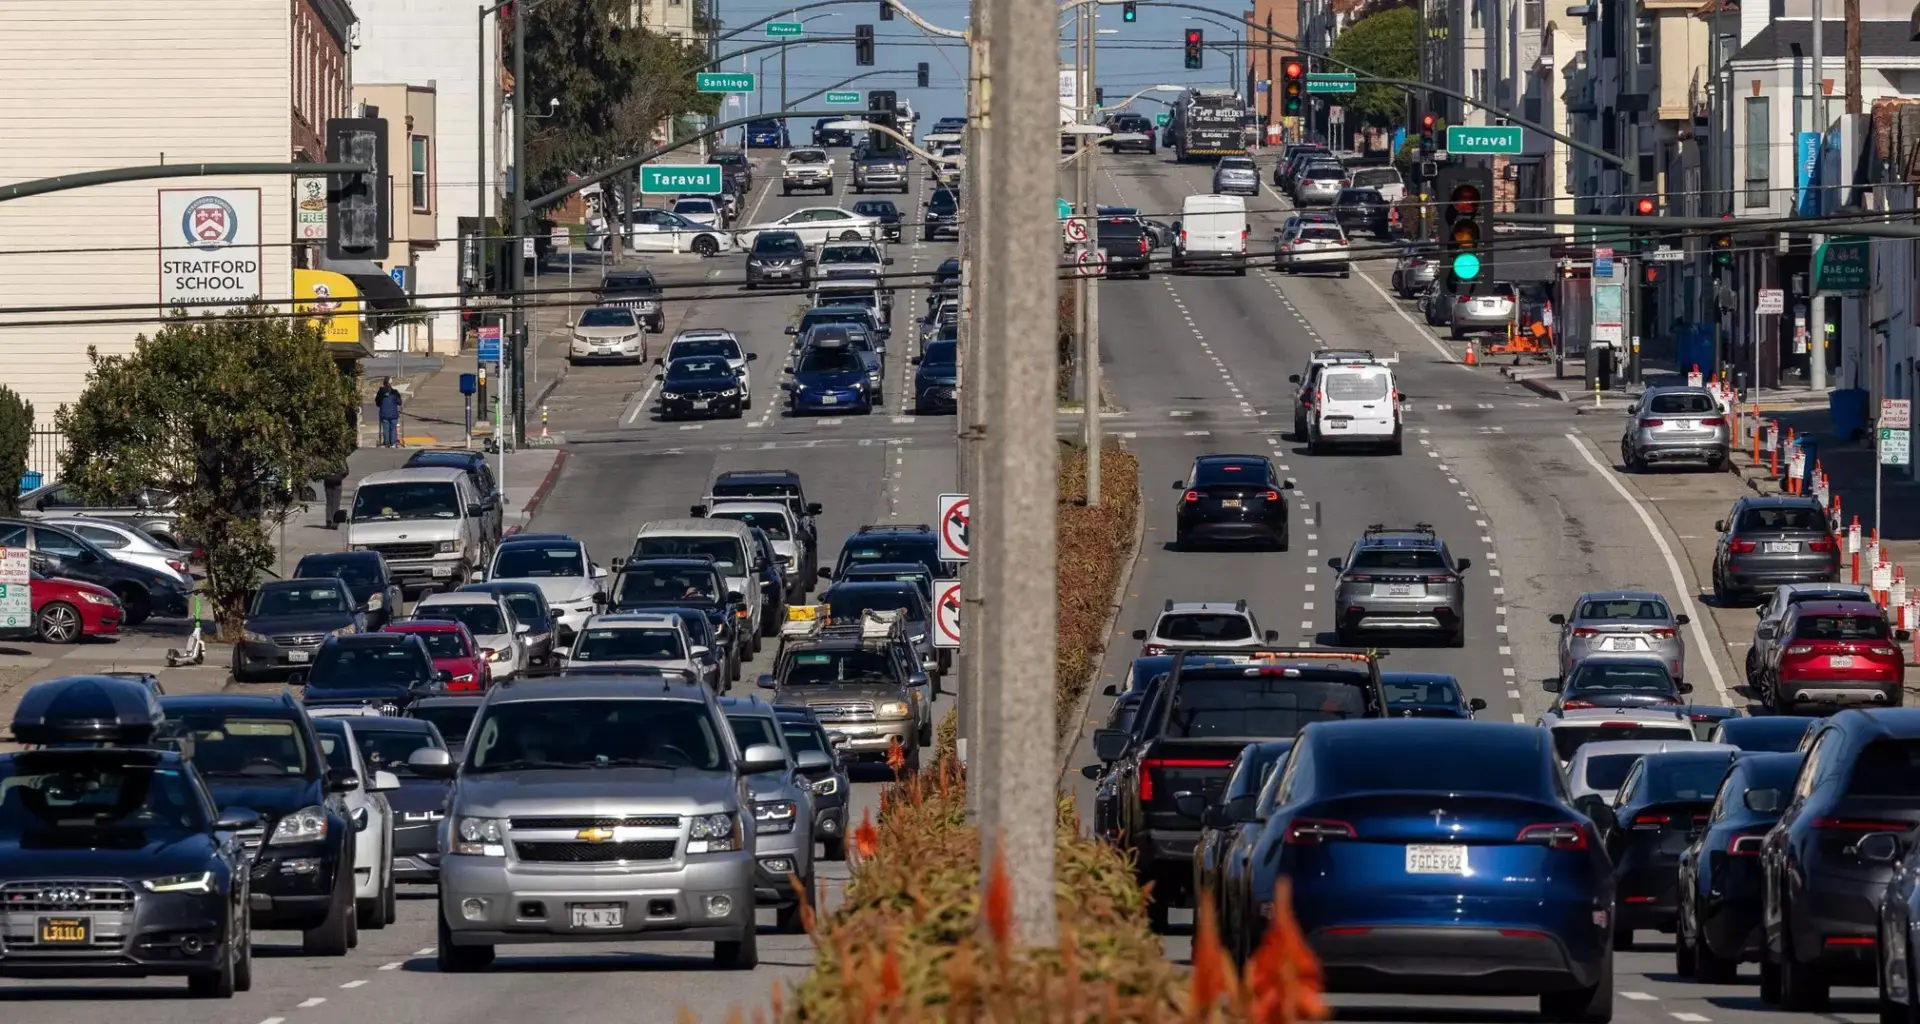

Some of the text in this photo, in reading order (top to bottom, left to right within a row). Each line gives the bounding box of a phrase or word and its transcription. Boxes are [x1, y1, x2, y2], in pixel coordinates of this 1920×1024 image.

[703, 79, 749, 87] Santiago
[1458, 134, 1512, 146] Taraval
[1806, 138, 1816, 178] citibank
[653, 174, 711, 185] Taraval
[163, 260, 257, 274] STRATFORD
[176, 276, 244, 290] SCHOOL
[8, 551, 28, 559] PARKING
[593, 912, 600, 923] N
